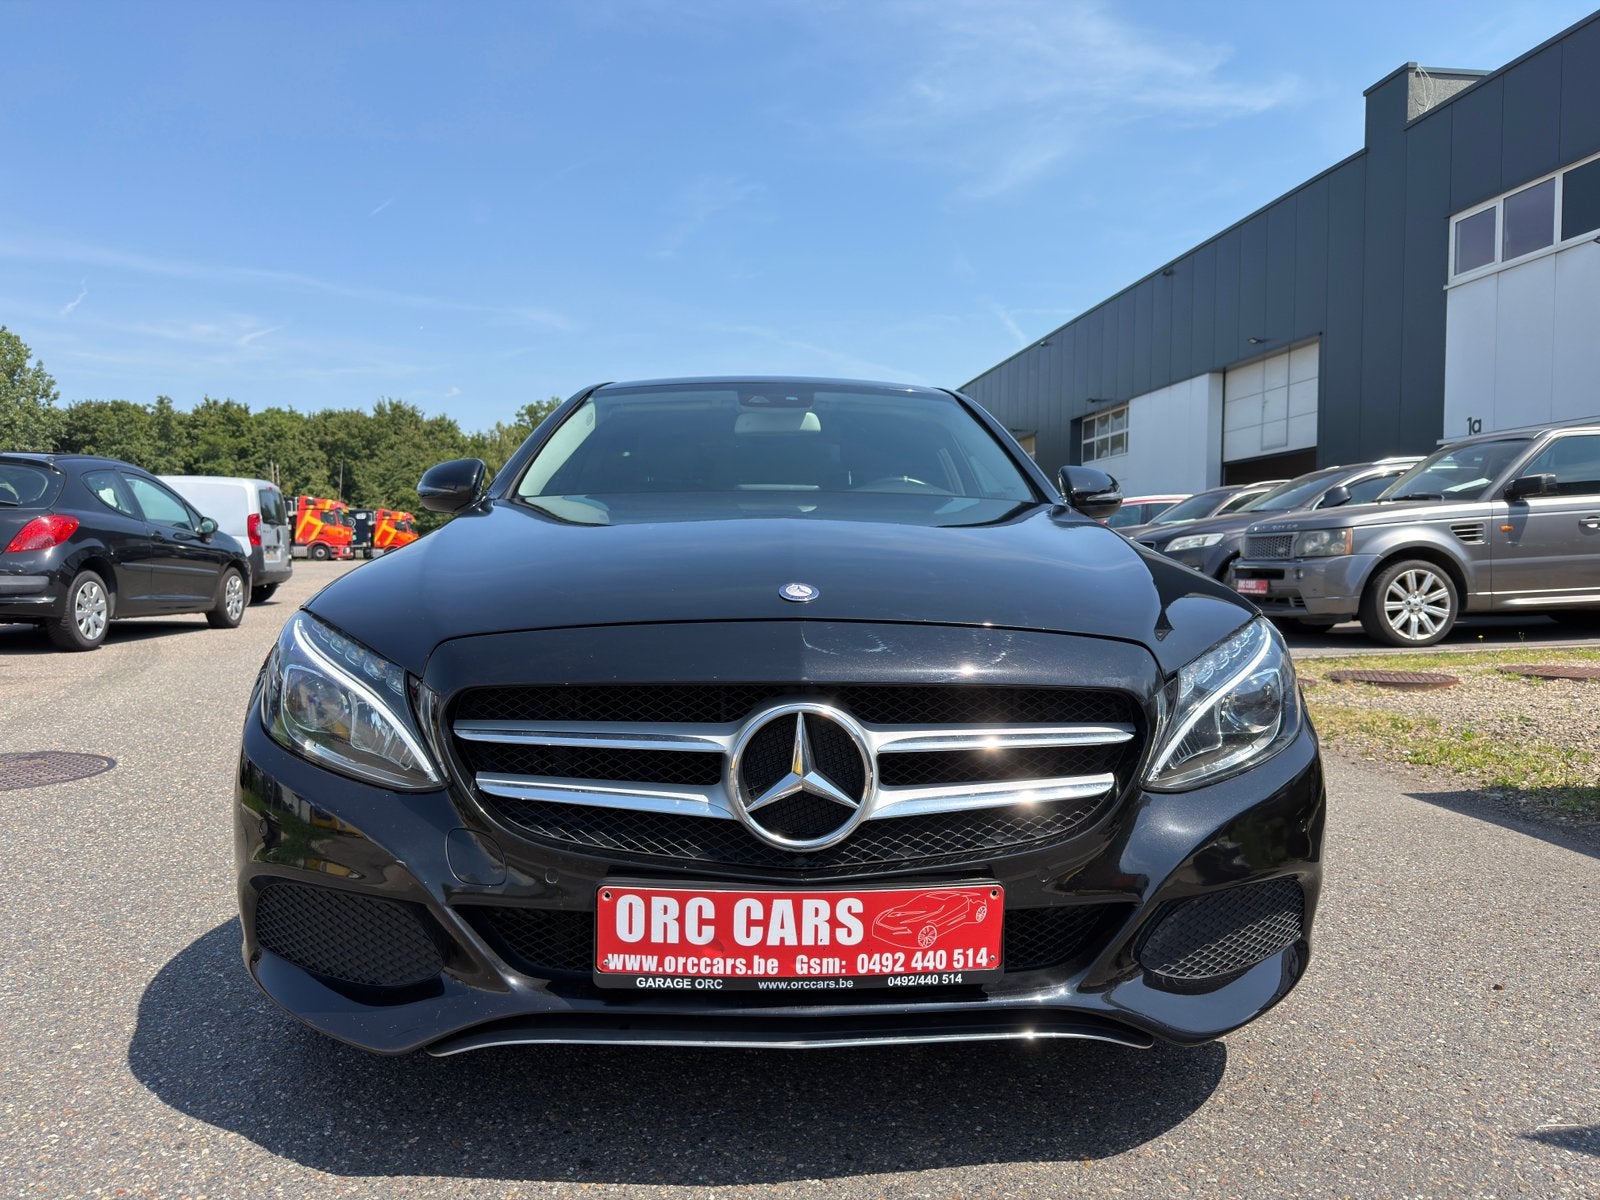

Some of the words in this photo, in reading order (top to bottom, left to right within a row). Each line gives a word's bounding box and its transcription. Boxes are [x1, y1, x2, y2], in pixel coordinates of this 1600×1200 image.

[1467, 416, 1482, 436] 1a
[616, 894, 716, 946] ORC
[733, 897, 864, 947] CARS
[607, 953, 779, 975] www.orccars.be
[795, 954, 846, 975] Gsm:
[857, 952, 905, 974] 0492
[911, 949, 947, 971] 440
[953, 947, 988, 968] 514
[636, 977, 691, 989] GARAGE
[694, 979, 723, 989] ORC
[758, 979, 854, 990] www.orccars.be
[887, 975, 938, 987] 0492/440
[941, 973, 963, 984] 514
